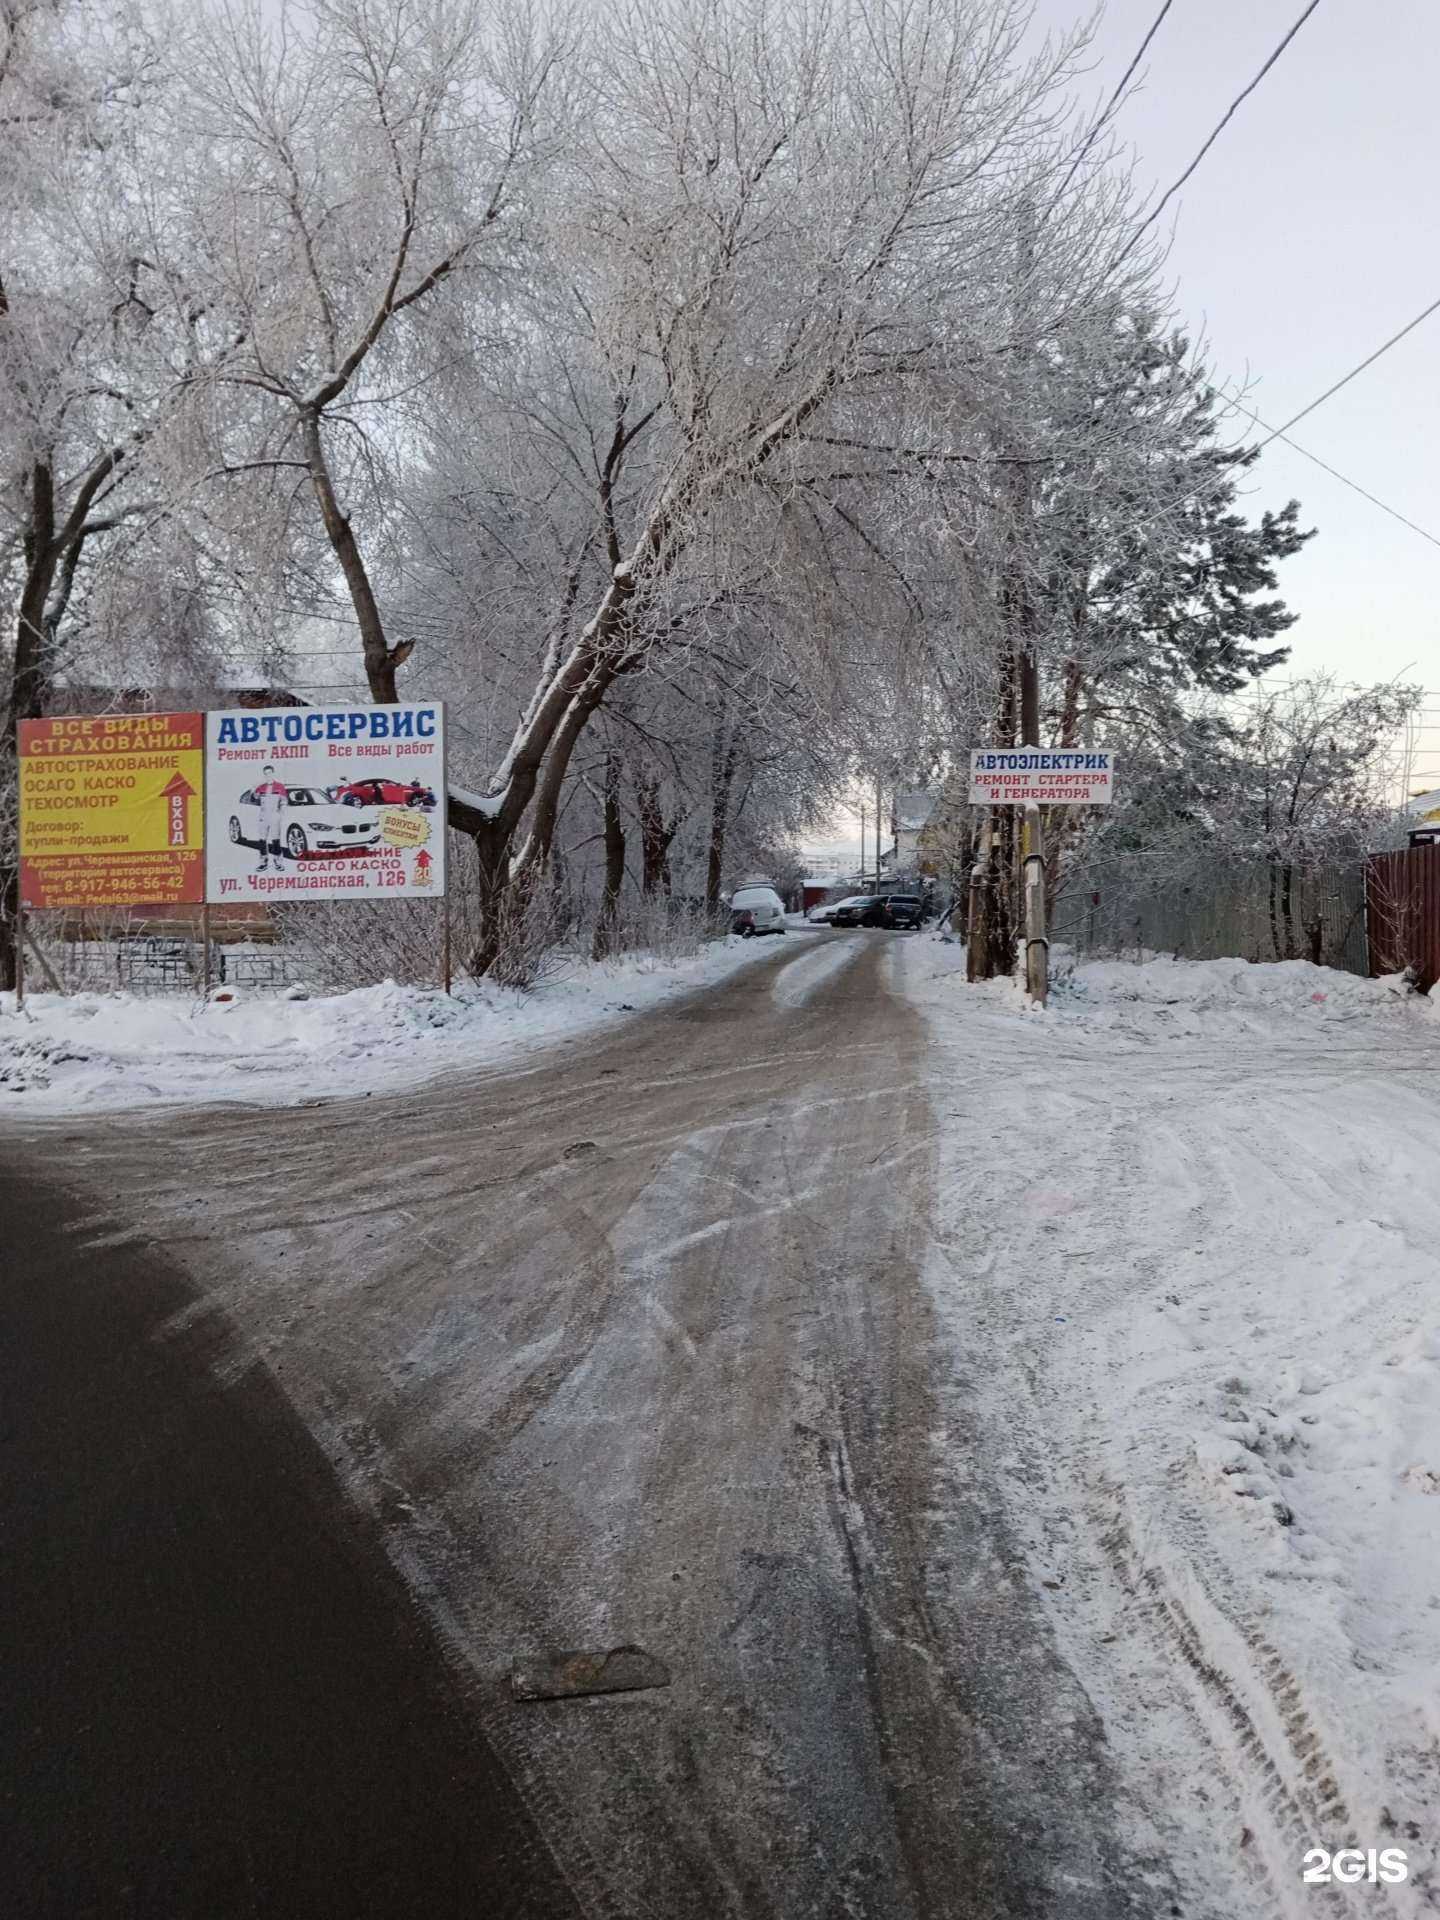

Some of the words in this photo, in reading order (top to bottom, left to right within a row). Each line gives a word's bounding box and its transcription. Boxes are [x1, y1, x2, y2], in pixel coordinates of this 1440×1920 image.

[52, 720, 93, 736] ВСЕ
[104, 717, 169, 735] ВИДЫ
[217, 709, 435, 743] АВТОСЕРВИС
[30, 733, 192, 753] СТРАХОВАНИЯ
[218, 748, 266, 761] Ремонт
[270, 745, 309, 759] АКПП
[328, 744, 352, 757] Все
[356, 742, 391, 756] виды
[396, 741, 434, 757] работ
[25, 755, 180, 775] АВТОСТРАХОВАНИЕ
[975, 754, 1109, 770] АВТОЭЛЕКТРИК
[24, 778, 76, 793] ОСАГО
[84, 775, 136, 791] КАСКО
[975, 774, 1030, 785] РЕМОНТ
[1038, 774, 1108, 785] СТАРТЕРА
[990, 788, 1000, 799] И
[1004, 788, 1090, 799] ГЕНЕРАТОРА
[25, 794, 119, 811] ТЕХОСМОТР
[26, 820, 84, 835] Договор:
[171, 795, 185, 845] ВХОД
[26, 833, 129, 849] купли-продажи
[176, 850, 197, 862] 126
[297, 860, 346, 872] ОСАГО
[351, 858, 401, 871] КАСКО
[65, 876, 184, 893] 8-917-946-56-42
[220, 878, 242, 895] ул.
[248, 873, 370, 893] Черемшанская,
[376, 870, 406, 887] 126
